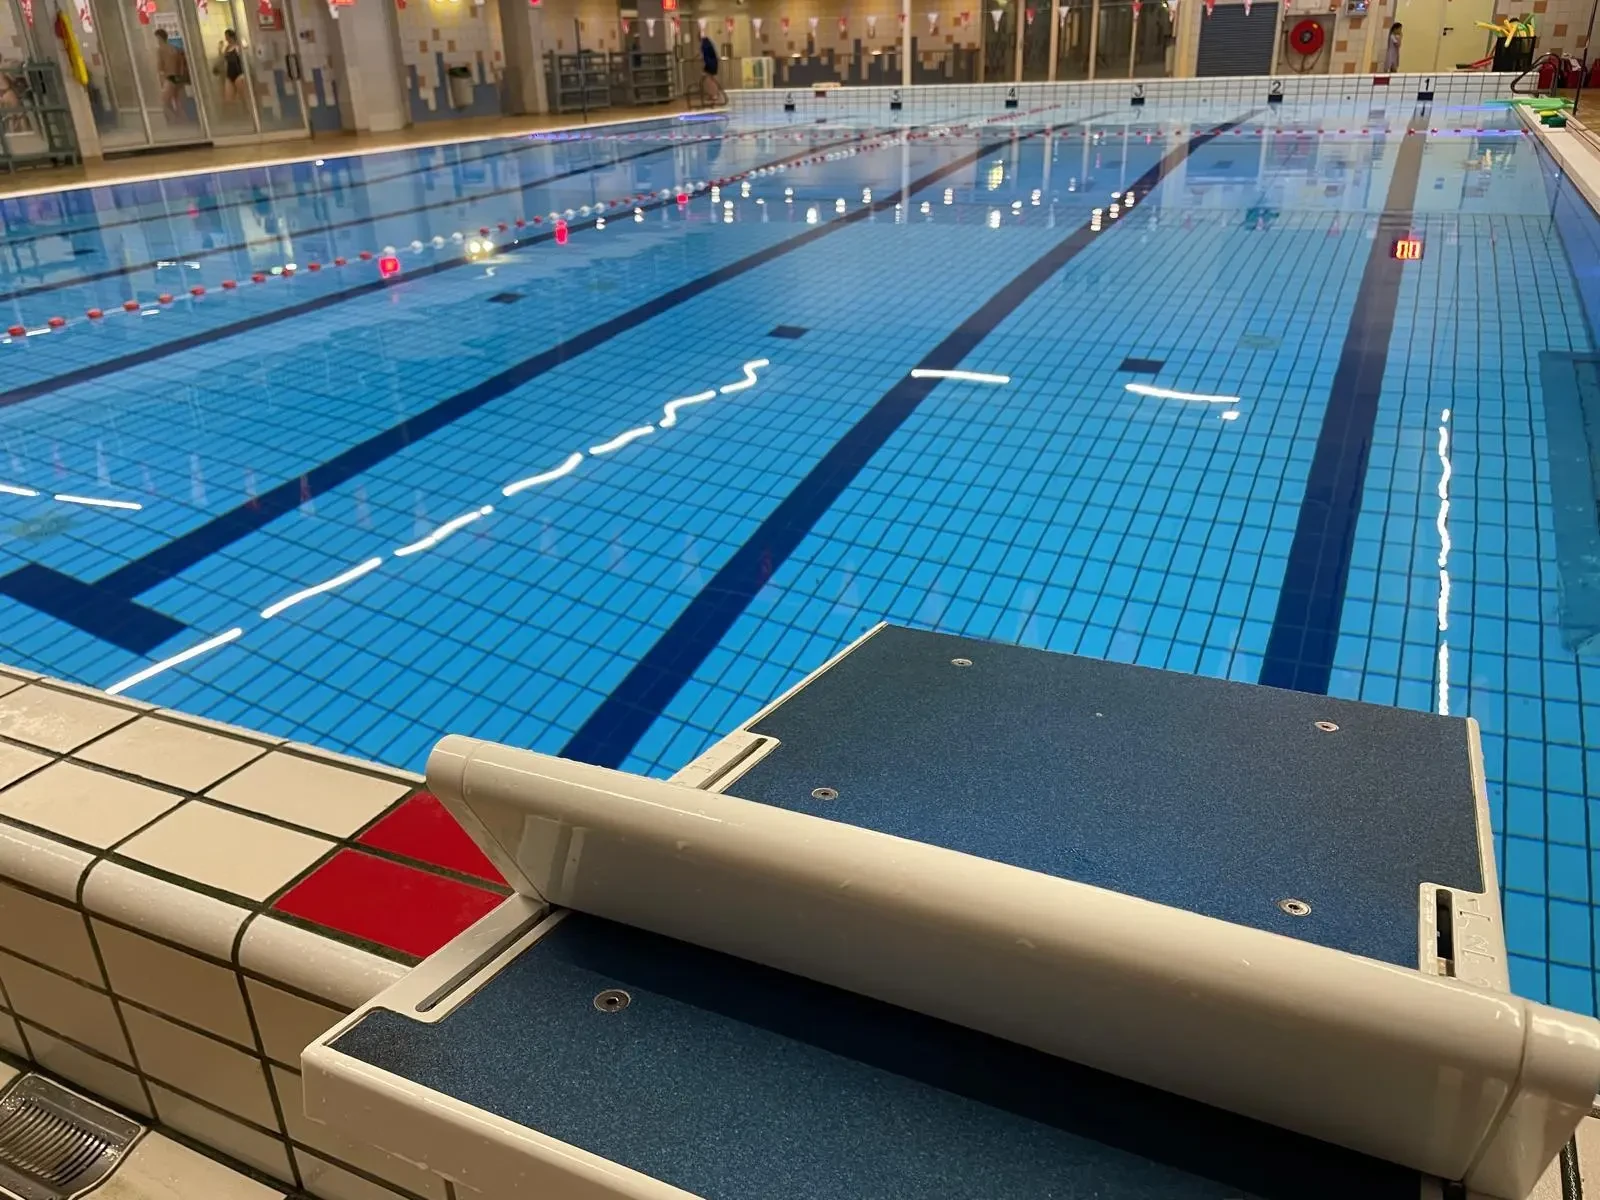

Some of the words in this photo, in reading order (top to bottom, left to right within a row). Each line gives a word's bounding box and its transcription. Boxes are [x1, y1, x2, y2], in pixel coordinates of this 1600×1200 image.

[1134, 83, 1143, 97] 3
[1272, 81, 1282, 94] 2
[891, 89, 901, 101] 5
